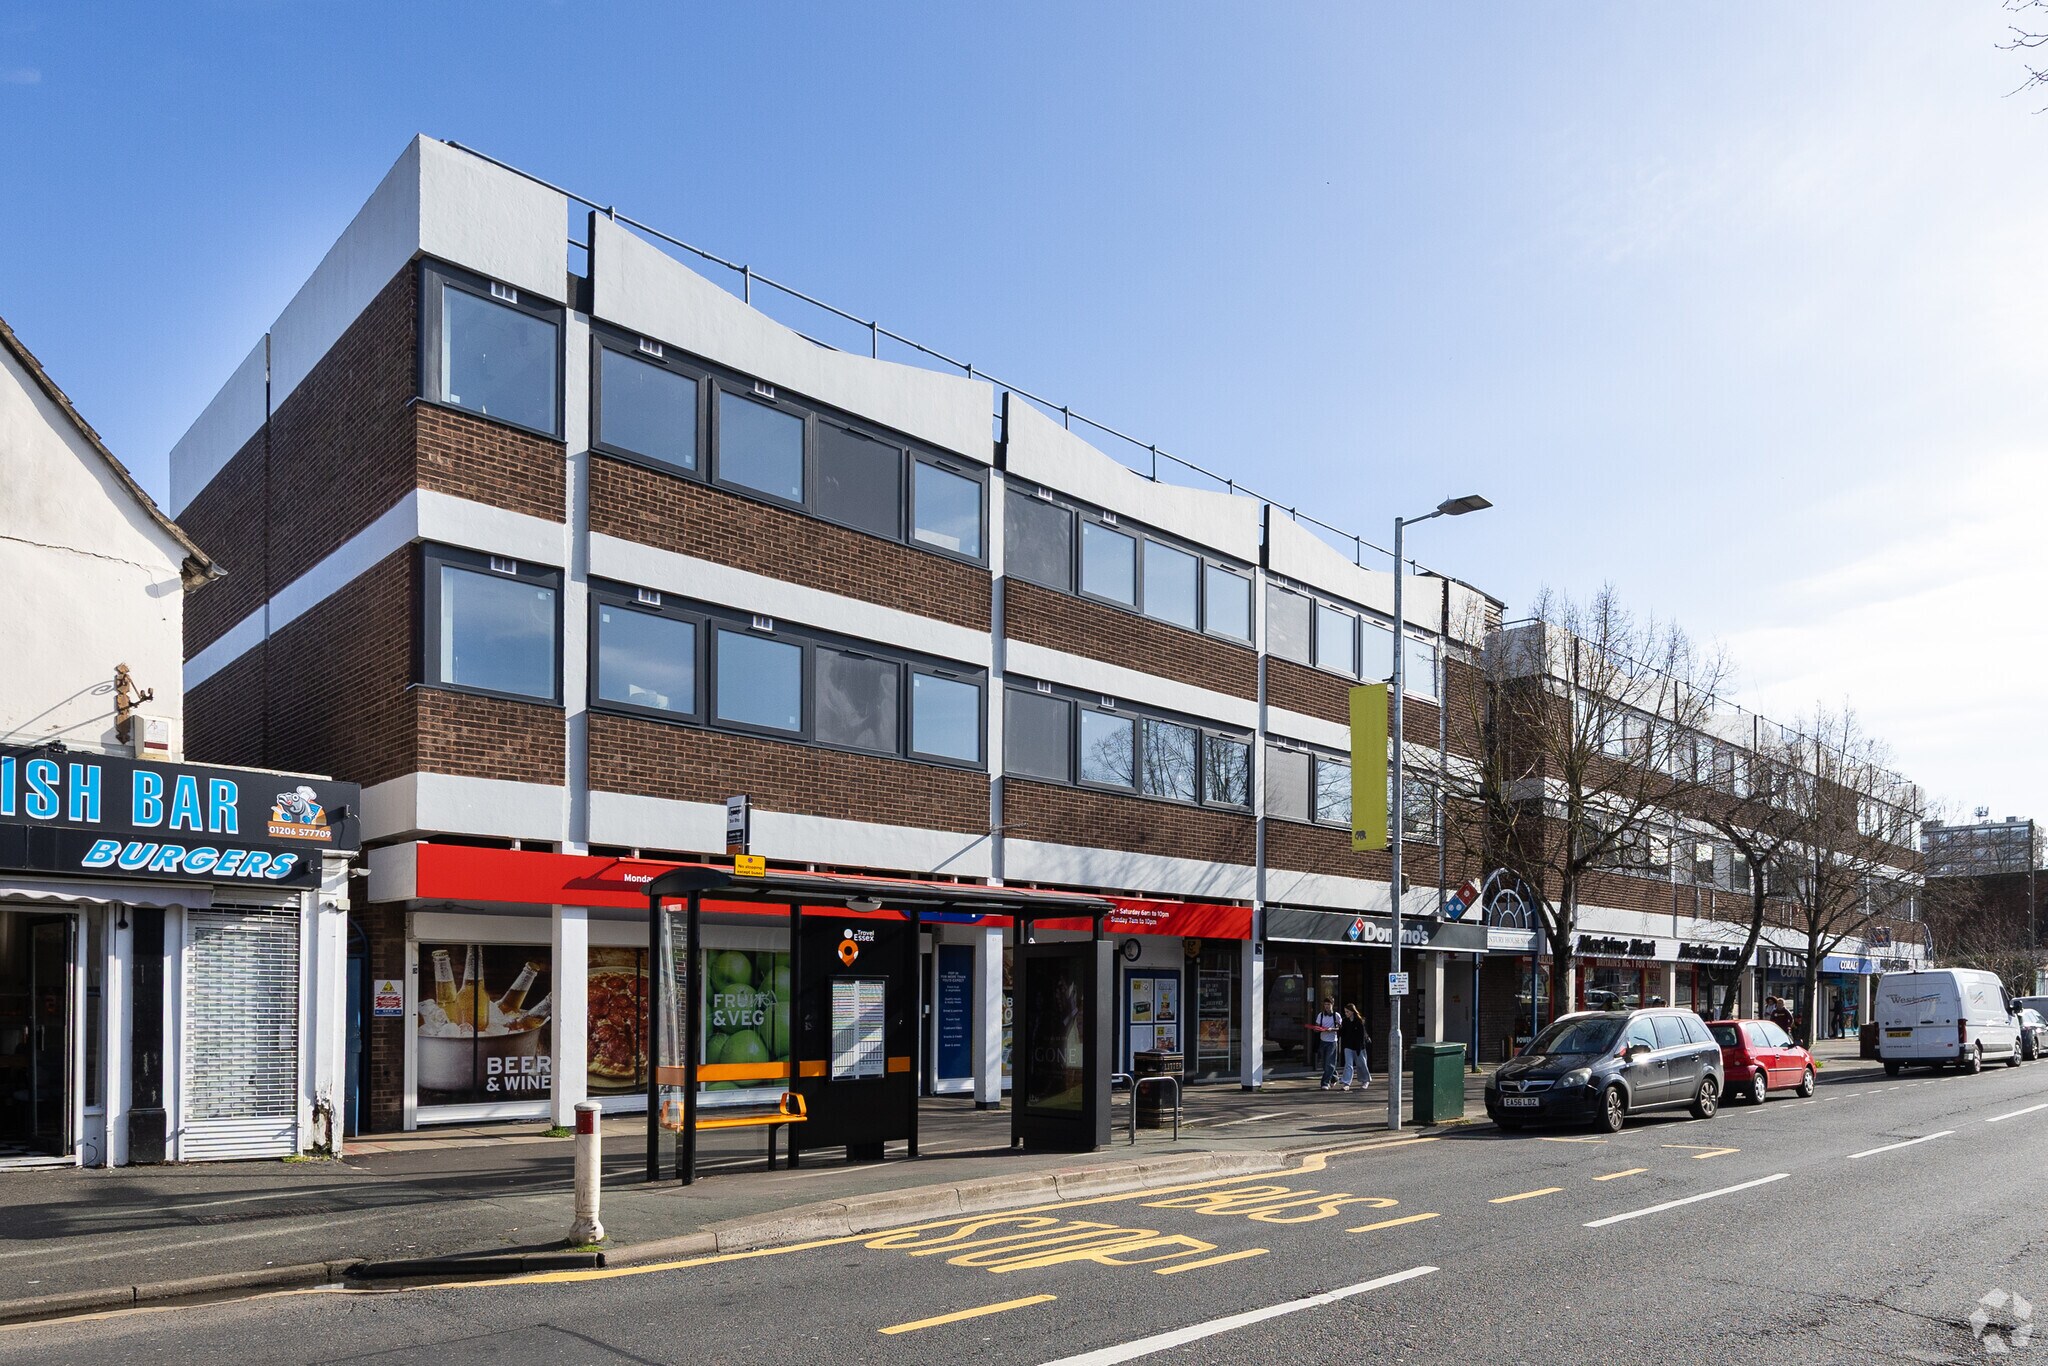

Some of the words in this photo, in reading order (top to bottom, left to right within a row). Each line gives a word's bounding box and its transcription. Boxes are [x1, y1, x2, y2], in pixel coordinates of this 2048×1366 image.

[132, 769, 239, 835] BAR
[269, 826, 296, 836] 01206
[298, 828, 332, 838] 577709
[82, 839, 298, 879] BURGERS
[1120, 908, 1140, 916] Saturday
[1635, 960, 1645, 968] FOR
[1646, 961, 1661, 969] TOOLS
[714, 994, 762, 1008] FRUIT
[1035, 1048, 1077, 1064] GONE
[487, 1056, 551, 1074] BEER
[1164, 1062, 1182, 1070] LITTER
[486, 1077, 500, 1092] &
[504, 1075, 551, 1090] WINE
[1140, 1186, 1398, 1224] BUS
[864, 1216, 1218, 1273] STOP
